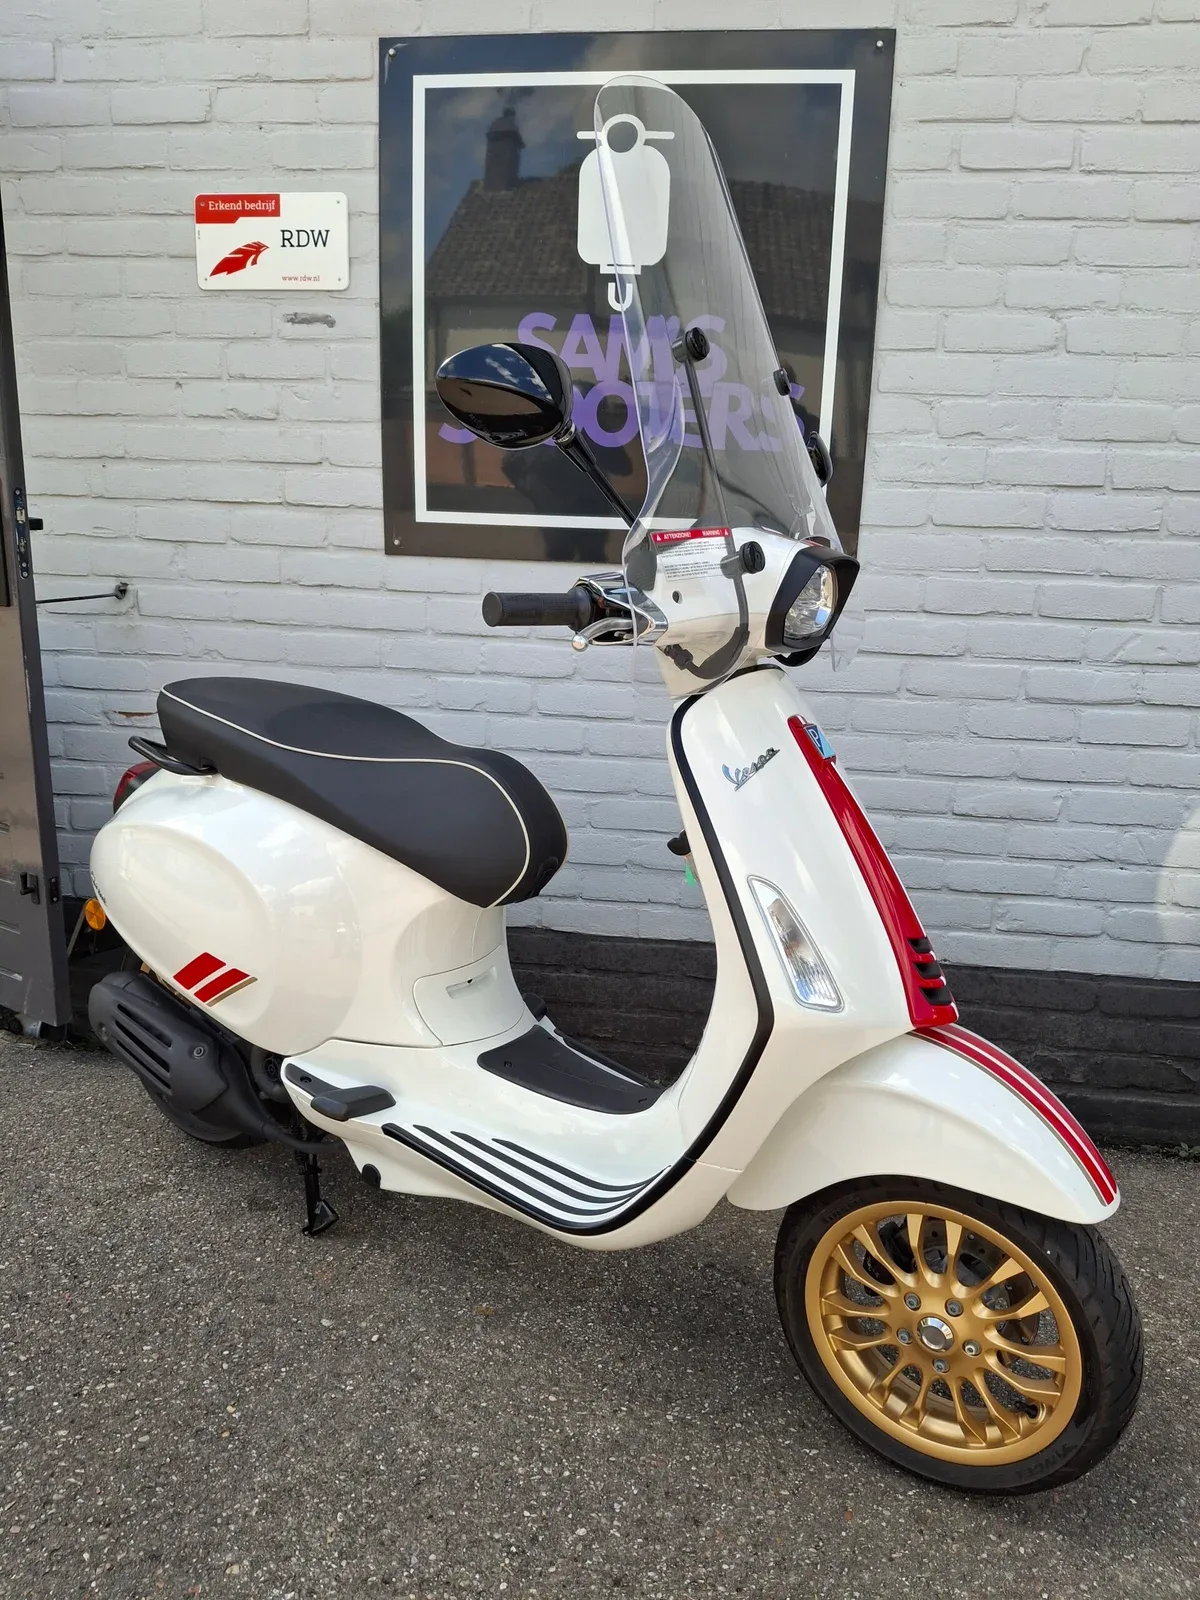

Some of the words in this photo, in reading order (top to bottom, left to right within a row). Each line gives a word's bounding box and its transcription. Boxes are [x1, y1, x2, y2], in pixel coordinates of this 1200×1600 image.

[208, 200, 243, 211] Erkend
[244, 199, 276, 212] bedrijf
[279, 229, 331, 248] RDW
[281, 274, 321, 282] www.rdw.nl
[722, 747, 780, 792] Vespa
